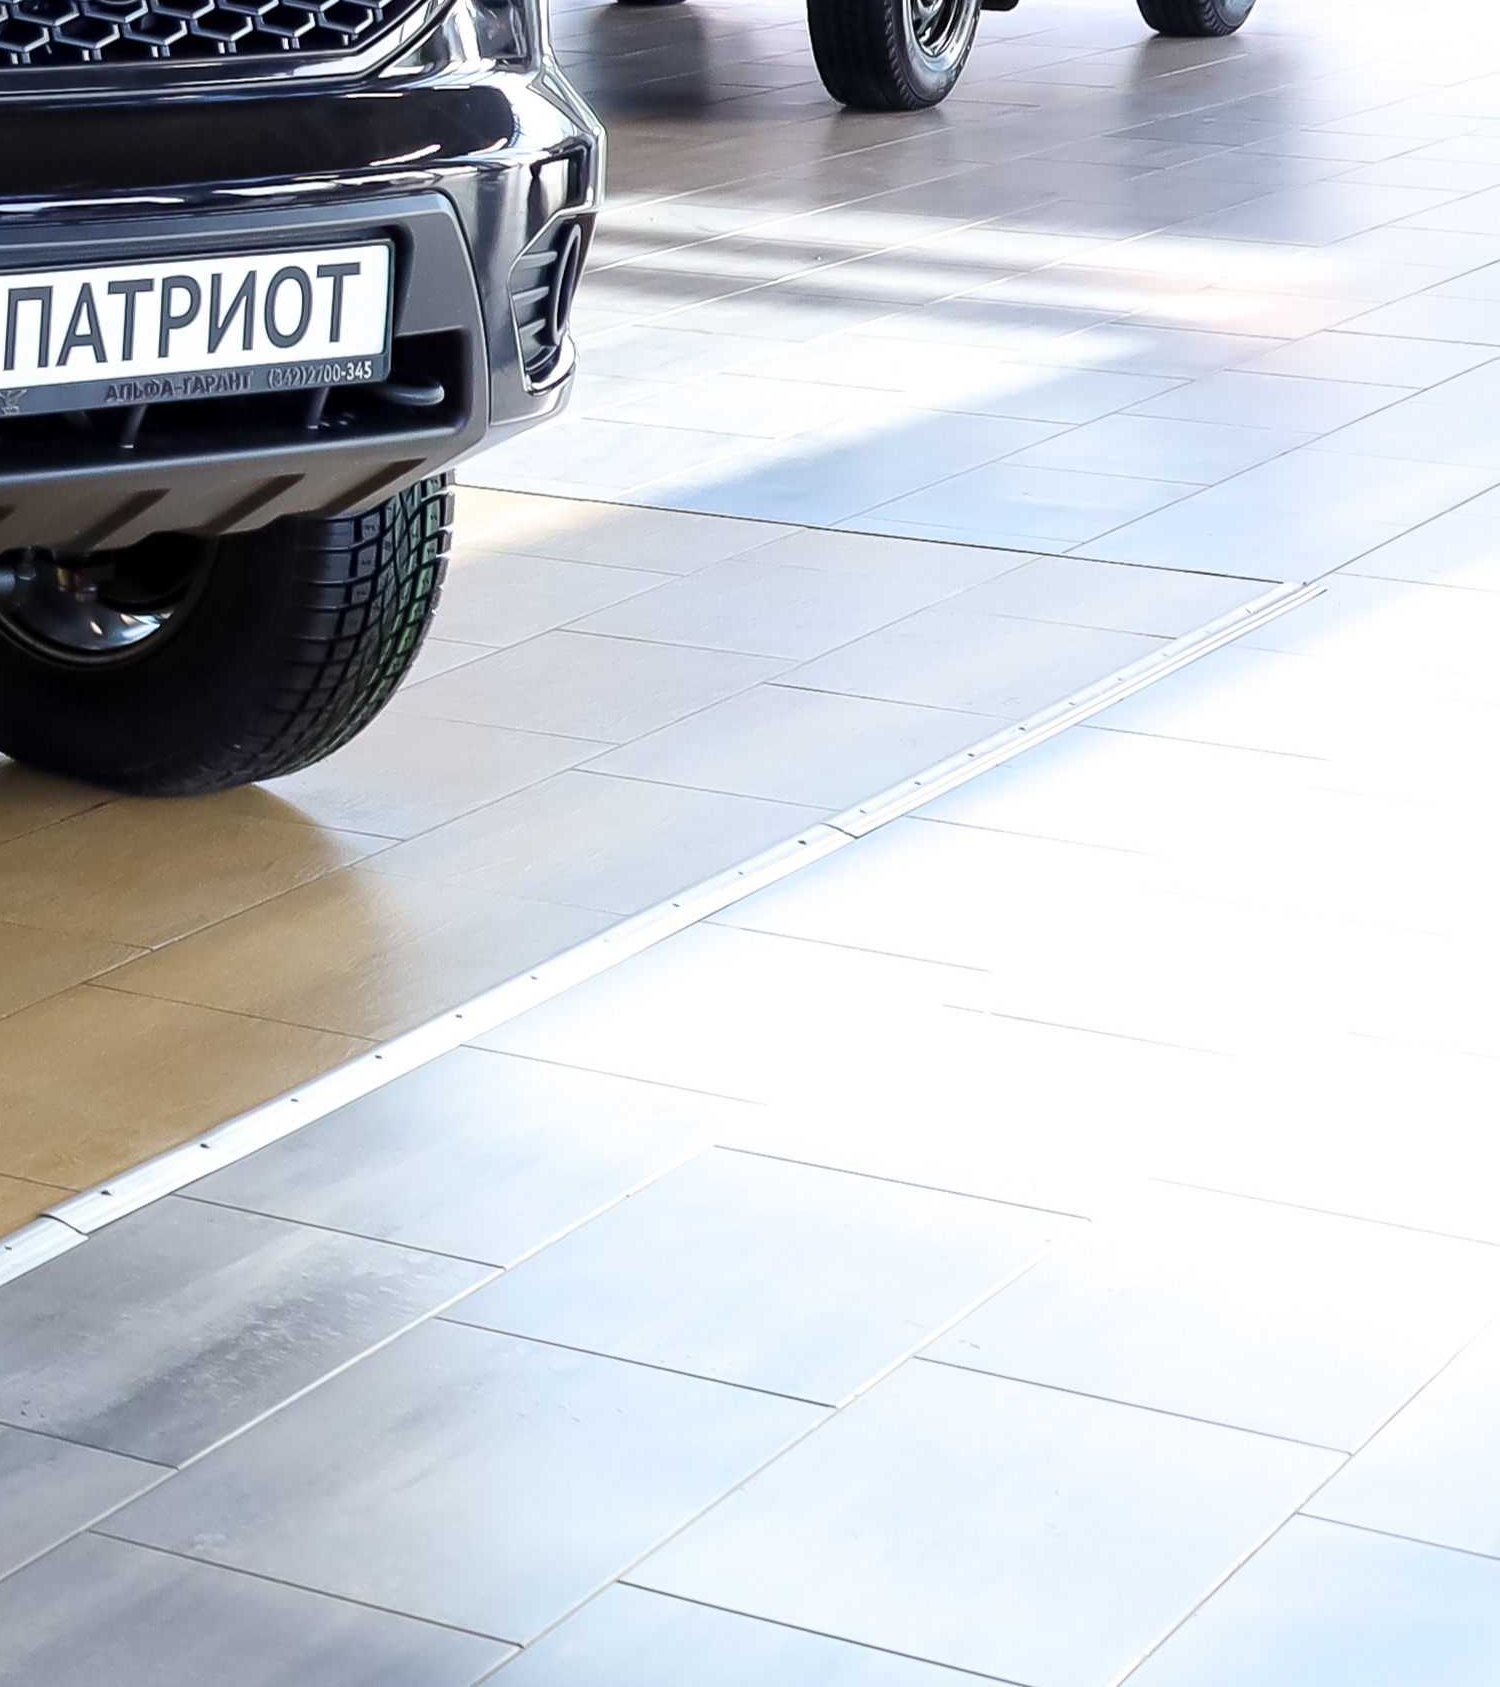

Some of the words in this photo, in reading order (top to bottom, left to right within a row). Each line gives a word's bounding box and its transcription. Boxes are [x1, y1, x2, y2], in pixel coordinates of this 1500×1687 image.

[2, 261, 362, 372] ПАТРИОТ
[104, 372, 255, 404] АЛЬФА-ГАРАНТ
[266, 360, 373, 390] (342)2700-345
